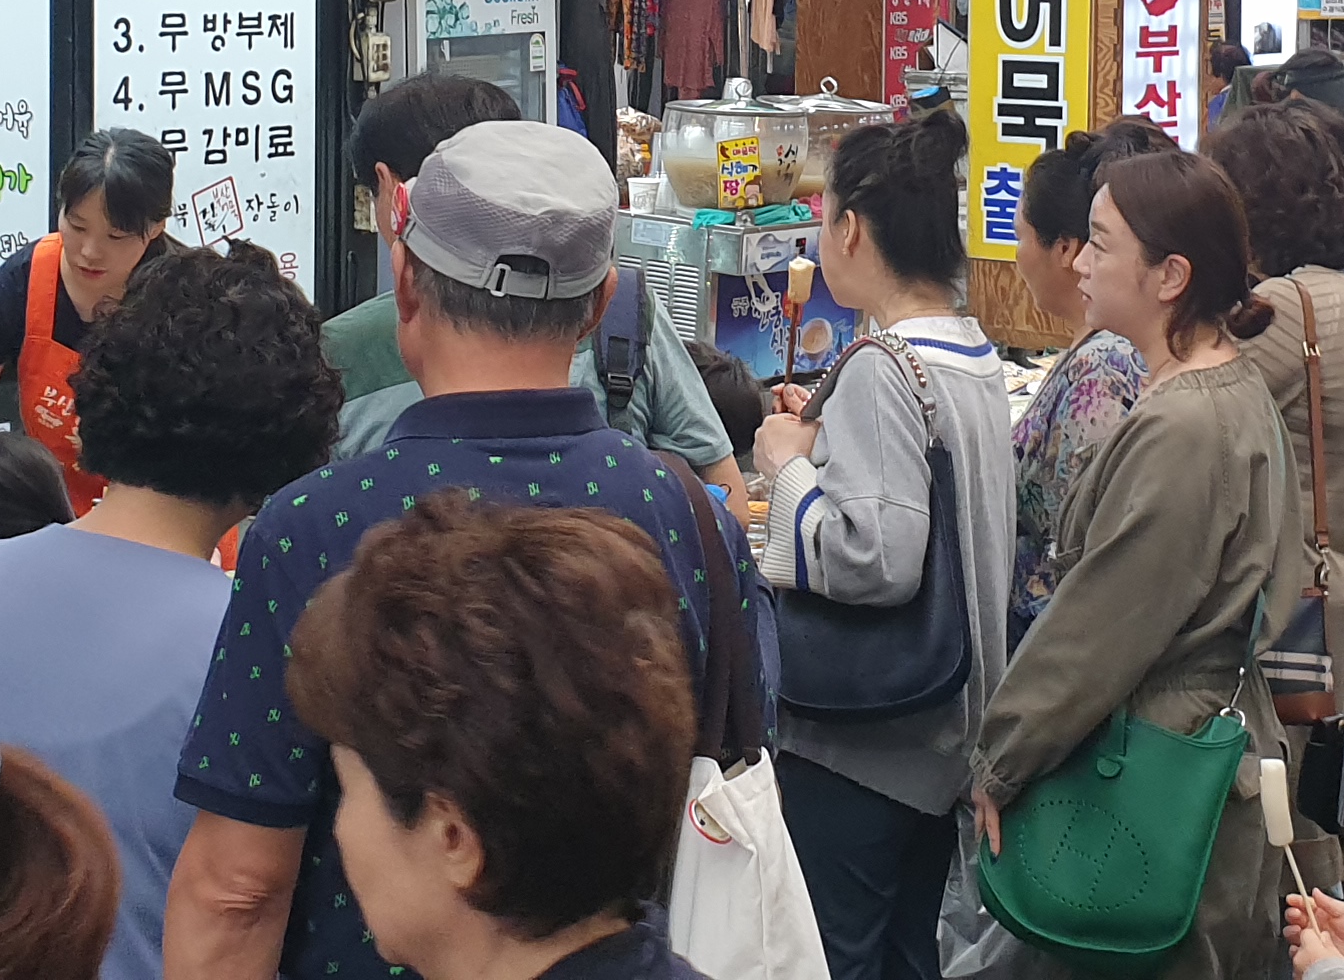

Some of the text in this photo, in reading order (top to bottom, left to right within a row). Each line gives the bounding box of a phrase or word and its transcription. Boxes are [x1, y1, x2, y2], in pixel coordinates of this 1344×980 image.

[510, 5, 539, 26] Fresh
[890, 12, 908, 25] KBS
[158, 12, 190, 54] 무
[202, 12, 296, 53] 방부제
[890, 46, 908, 59] KBS
[158, 70, 189, 111] 무
[1135, 24, 1182, 144] 부산
[890, 94, 908, 107] KBS
[202, 124, 296, 166] 감미료
[245, 193, 300, 223] 장돌이
